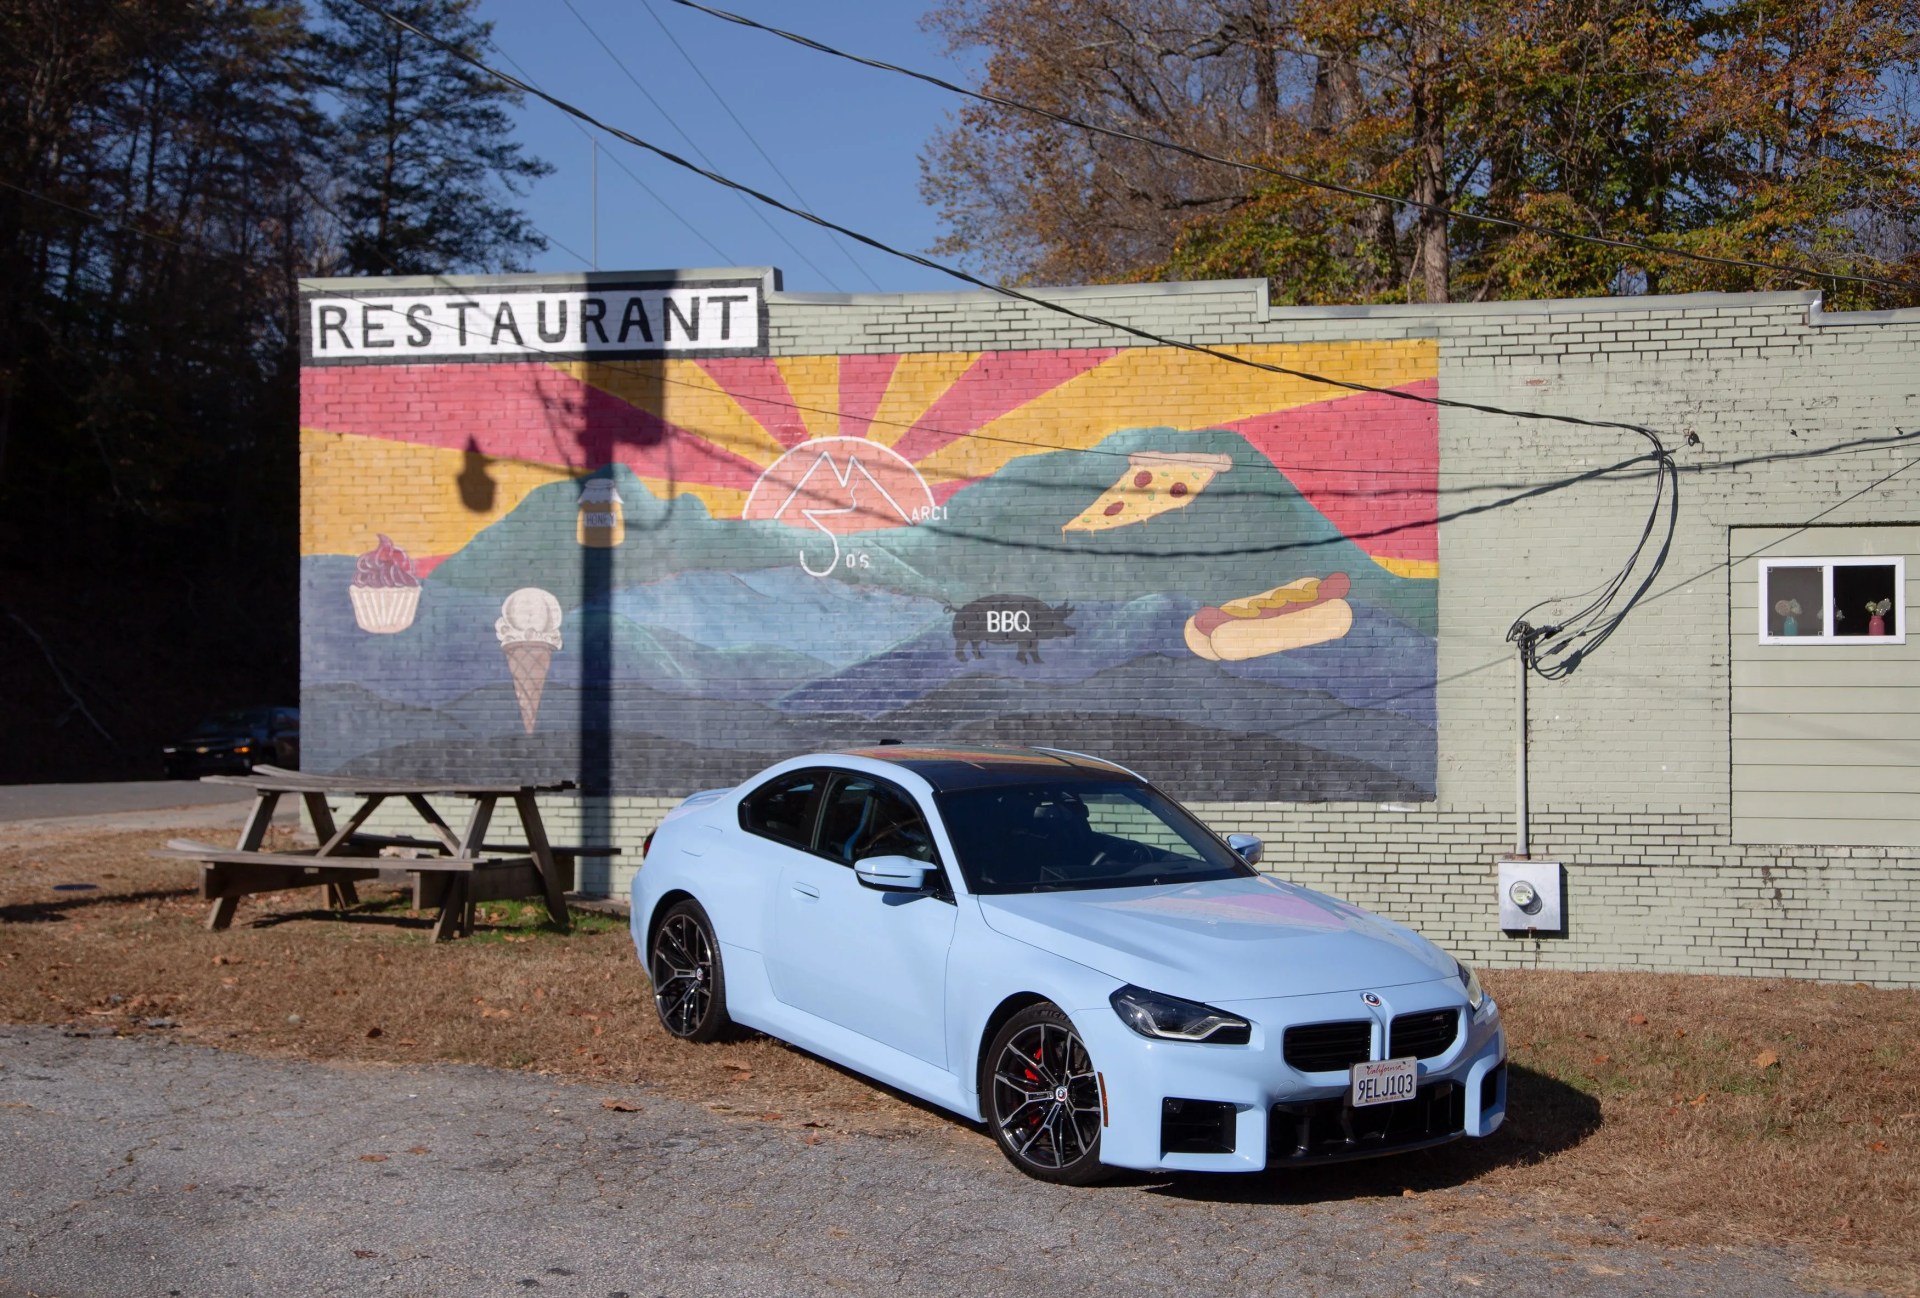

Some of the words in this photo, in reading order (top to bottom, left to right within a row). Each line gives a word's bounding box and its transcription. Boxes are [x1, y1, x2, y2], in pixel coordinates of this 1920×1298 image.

[319, 295, 749, 349] RESTAURANT
[986, 610, 1032, 633] BBQ
[1367, 1064, 1404, 1076] California
[1358, 1074, 1413, 1100] 9ELJ103
